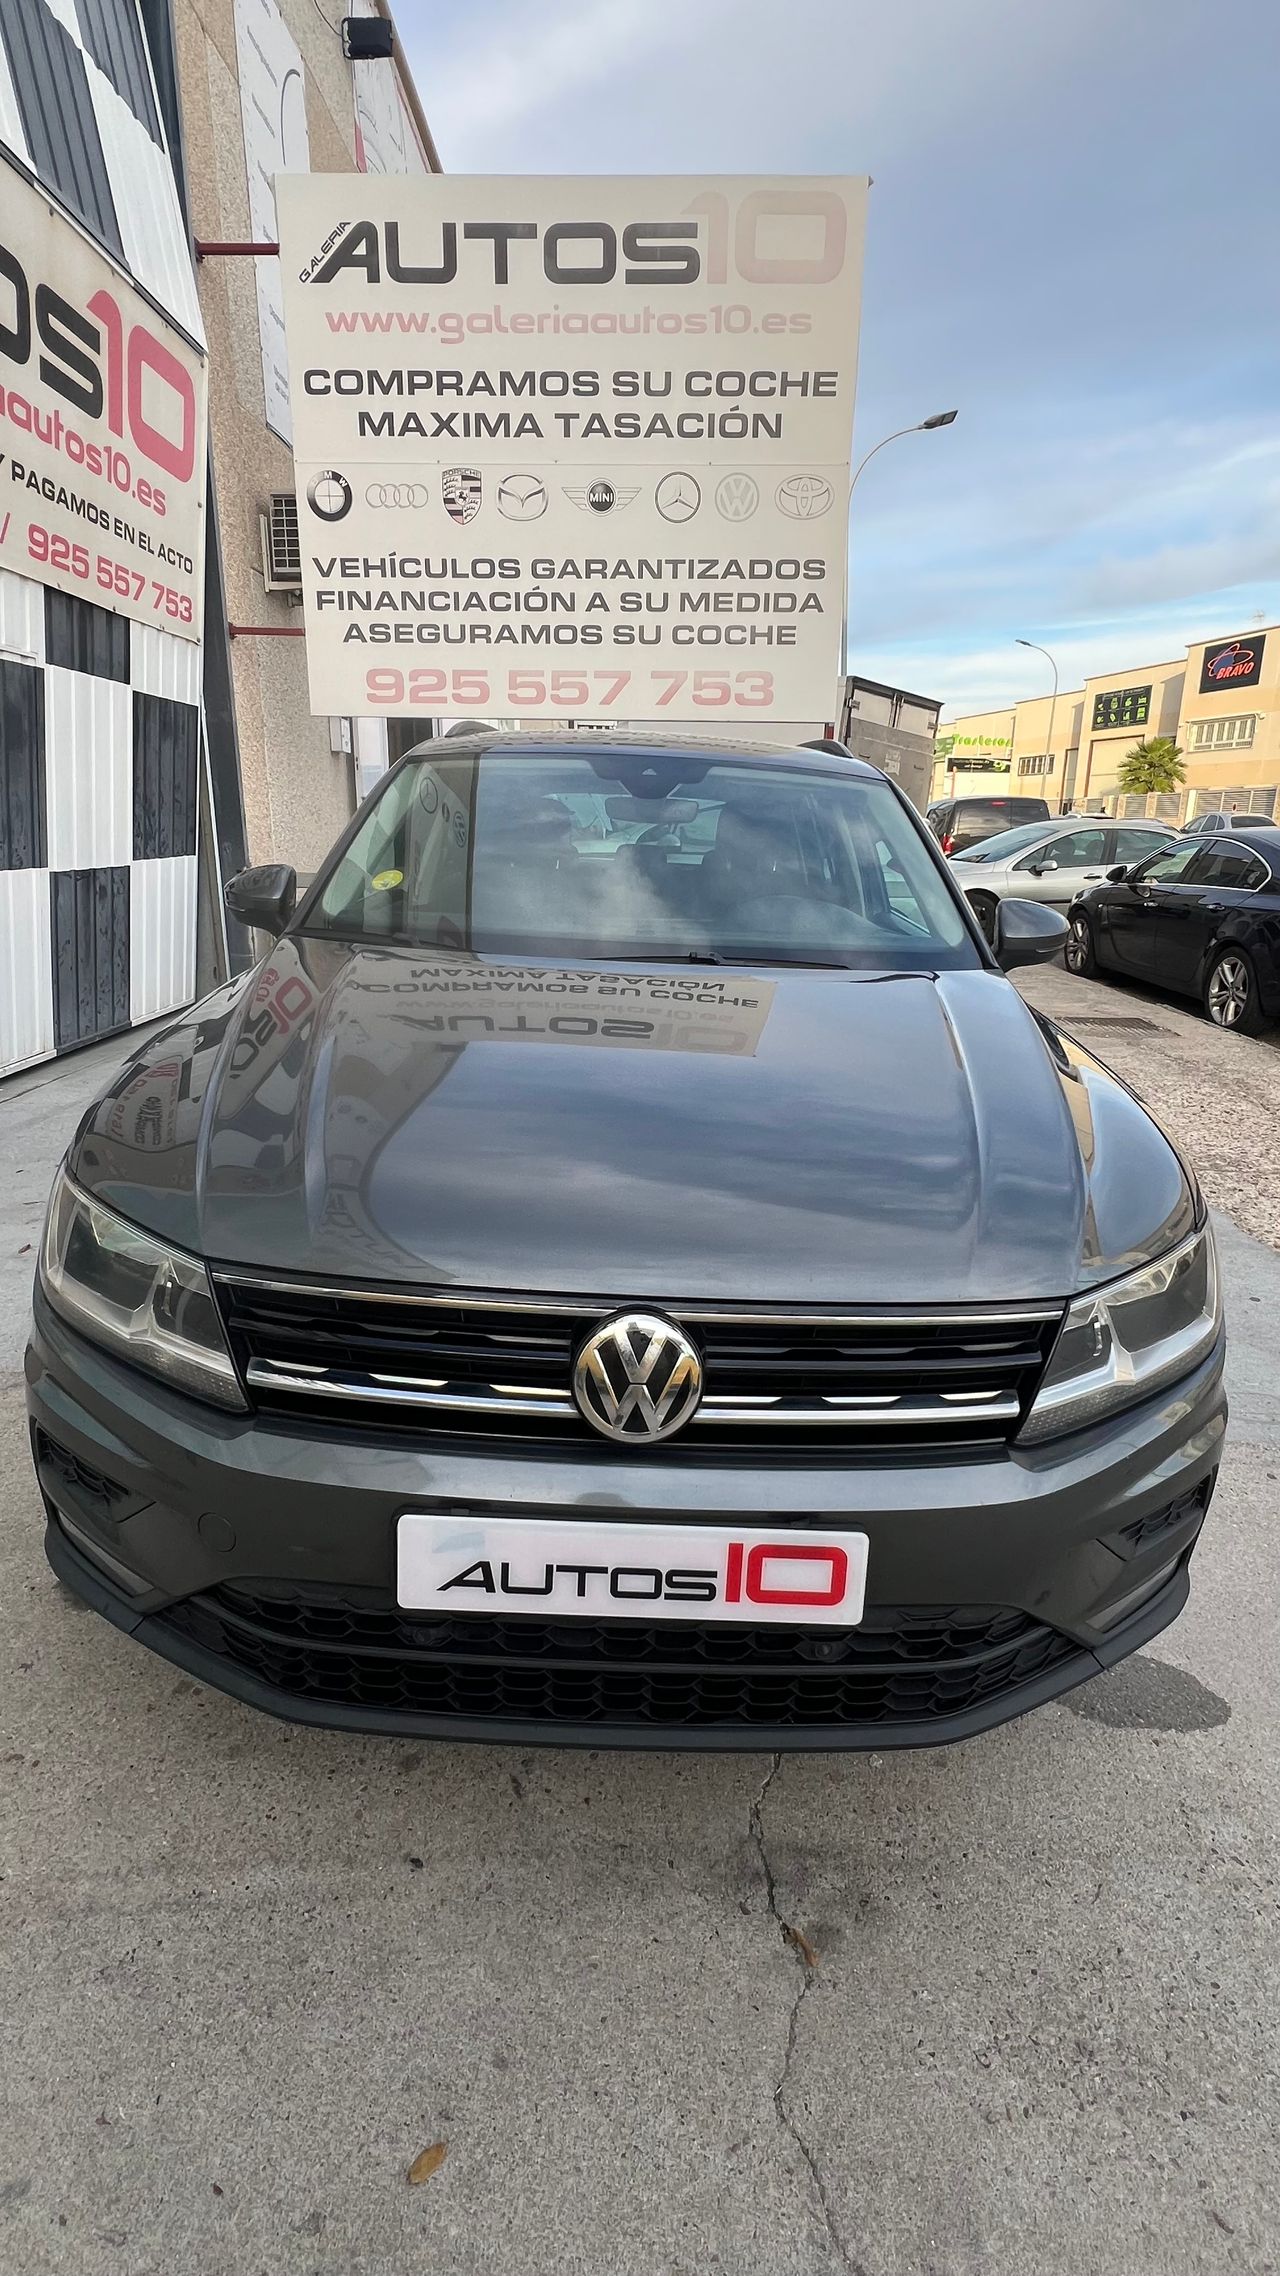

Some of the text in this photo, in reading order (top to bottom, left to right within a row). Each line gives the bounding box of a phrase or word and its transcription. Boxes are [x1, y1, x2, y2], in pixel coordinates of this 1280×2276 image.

[299, 222, 352, 283] GALERIA
[325, 304, 812, 344] www.galeriaautos10.es
[303, 369, 600, 397] COMPRAMOS
[612, 370, 672, 397] SU
[684, 371, 838, 397] COCHE
[358, 405, 783, 439] MAXIMA TASACIÓN
[0, 384, 166, 517] autos10.es
[589, 492, 615, 503] MINI
[11, 460, 193, 574] PAGAMOS EN EL ACTO
[28, 523, 90, 580] 925
[97, 555, 146, 601] 557
[152, 582, 193, 623] 753
[312, 552, 826, 580] VEHÍCULOS GARANTIZADOS
[316, 586, 824, 613] FINANCIACIÓN A SU MEDIDA
[342, 624, 797, 645] ASEGURAMOS SU COCHE
[365, 668, 775, 707] 925 557 753
[1215, 661, 1255, 680] BRAVO
[436, 1542, 849, 1607] AUTOS10
